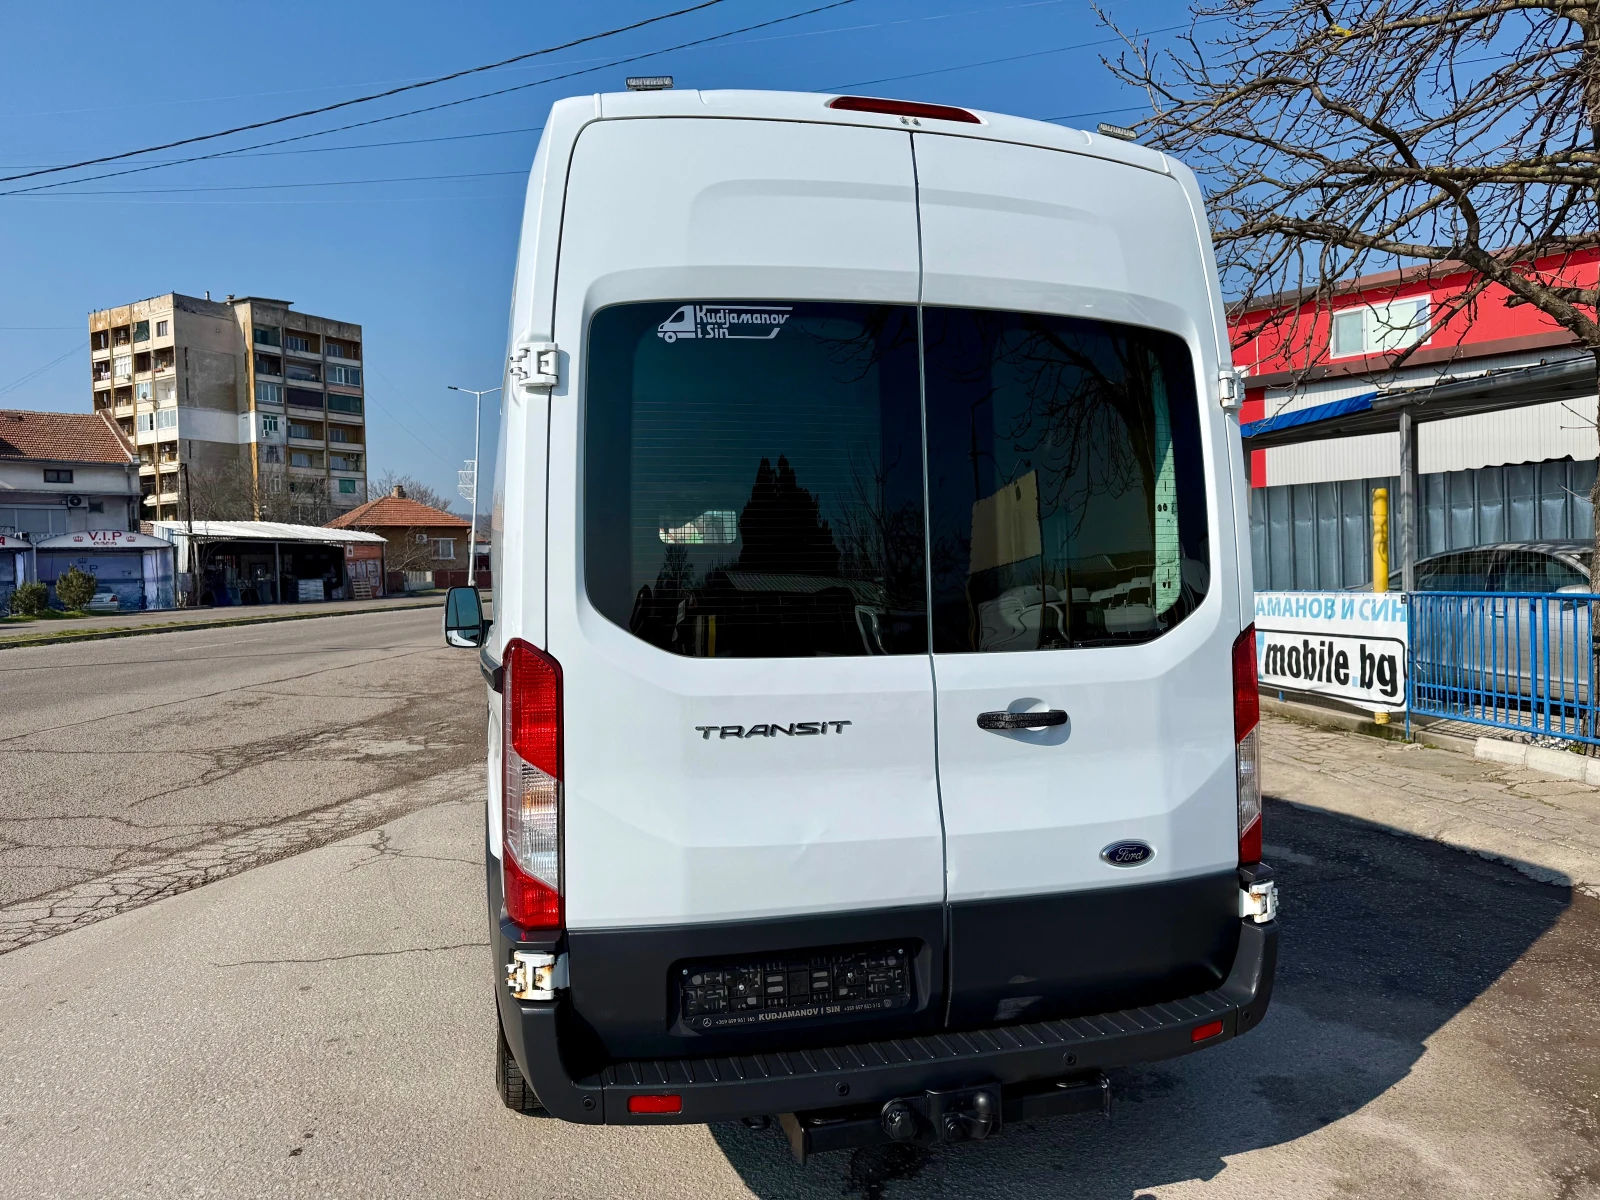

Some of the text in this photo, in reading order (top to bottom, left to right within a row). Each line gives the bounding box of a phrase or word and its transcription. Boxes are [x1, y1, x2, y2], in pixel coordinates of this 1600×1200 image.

[696, 305, 790, 328] Kudjamanov
[697, 325, 729, 339] i Sin
[87, 531, 122, 541] V.I.P
[1340, 598, 1354, 620] И
[1358, 599, 1407, 622] СИН
[1264, 639, 1398, 698] mobile.bg
[695, 720, 853, 740] TRANSIT
[1115, 846, 1144, 862] Ford
[758, 1007, 819, 1021] KUDJAMANOV
[825, 1005, 841, 1014] SIN
